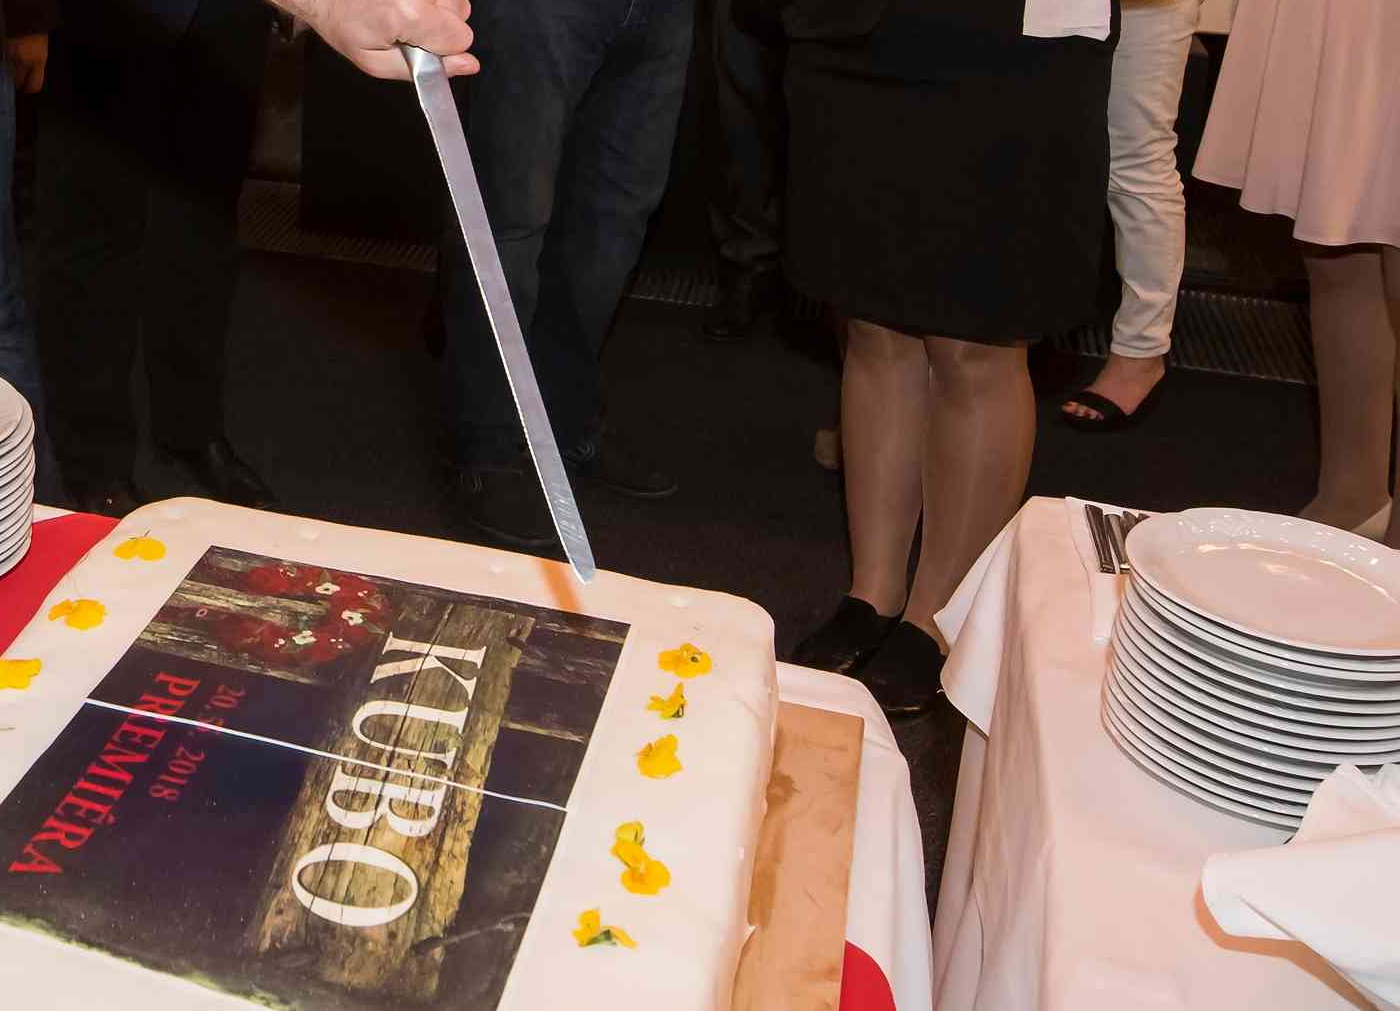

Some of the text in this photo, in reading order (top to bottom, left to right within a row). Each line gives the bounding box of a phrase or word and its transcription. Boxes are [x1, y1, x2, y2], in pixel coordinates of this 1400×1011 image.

[8, 671, 200, 874] PREMIÉRA
[149, 746, 207, 801] 2018
[291, 631, 487, 927] KUBO
